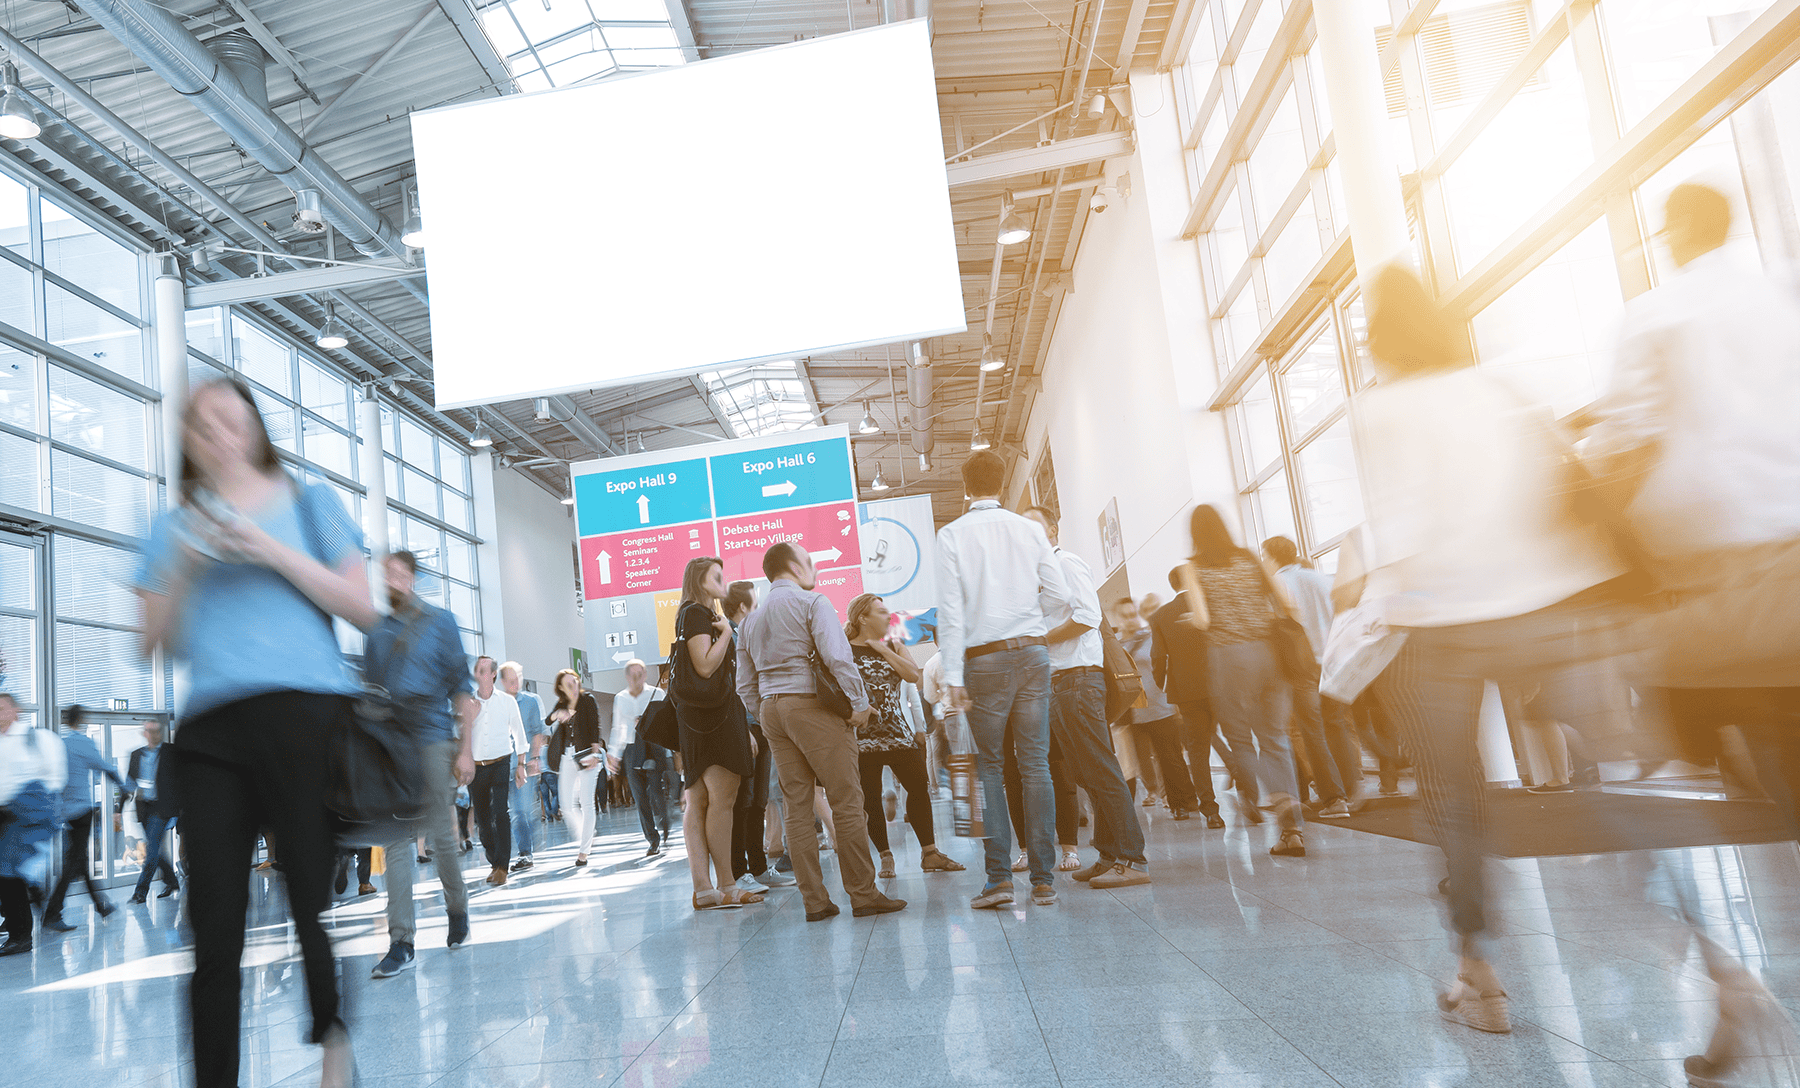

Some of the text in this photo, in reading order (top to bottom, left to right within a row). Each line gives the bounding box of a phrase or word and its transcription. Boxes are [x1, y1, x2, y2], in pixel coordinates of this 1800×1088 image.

[742, 452, 816, 475] Expo Hall 6
[606, 472, 677, 494] Expo Hall 9
[722, 518, 783, 536] Debate Hall
[622, 532, 674, 546] Congress Hall
[724, 532, 804, 550] Start-up Village
[623, 546, 658, 557] Seminars
[626, 580, 652, 588] Corner
[818, 577, 846, 586] Lounge
